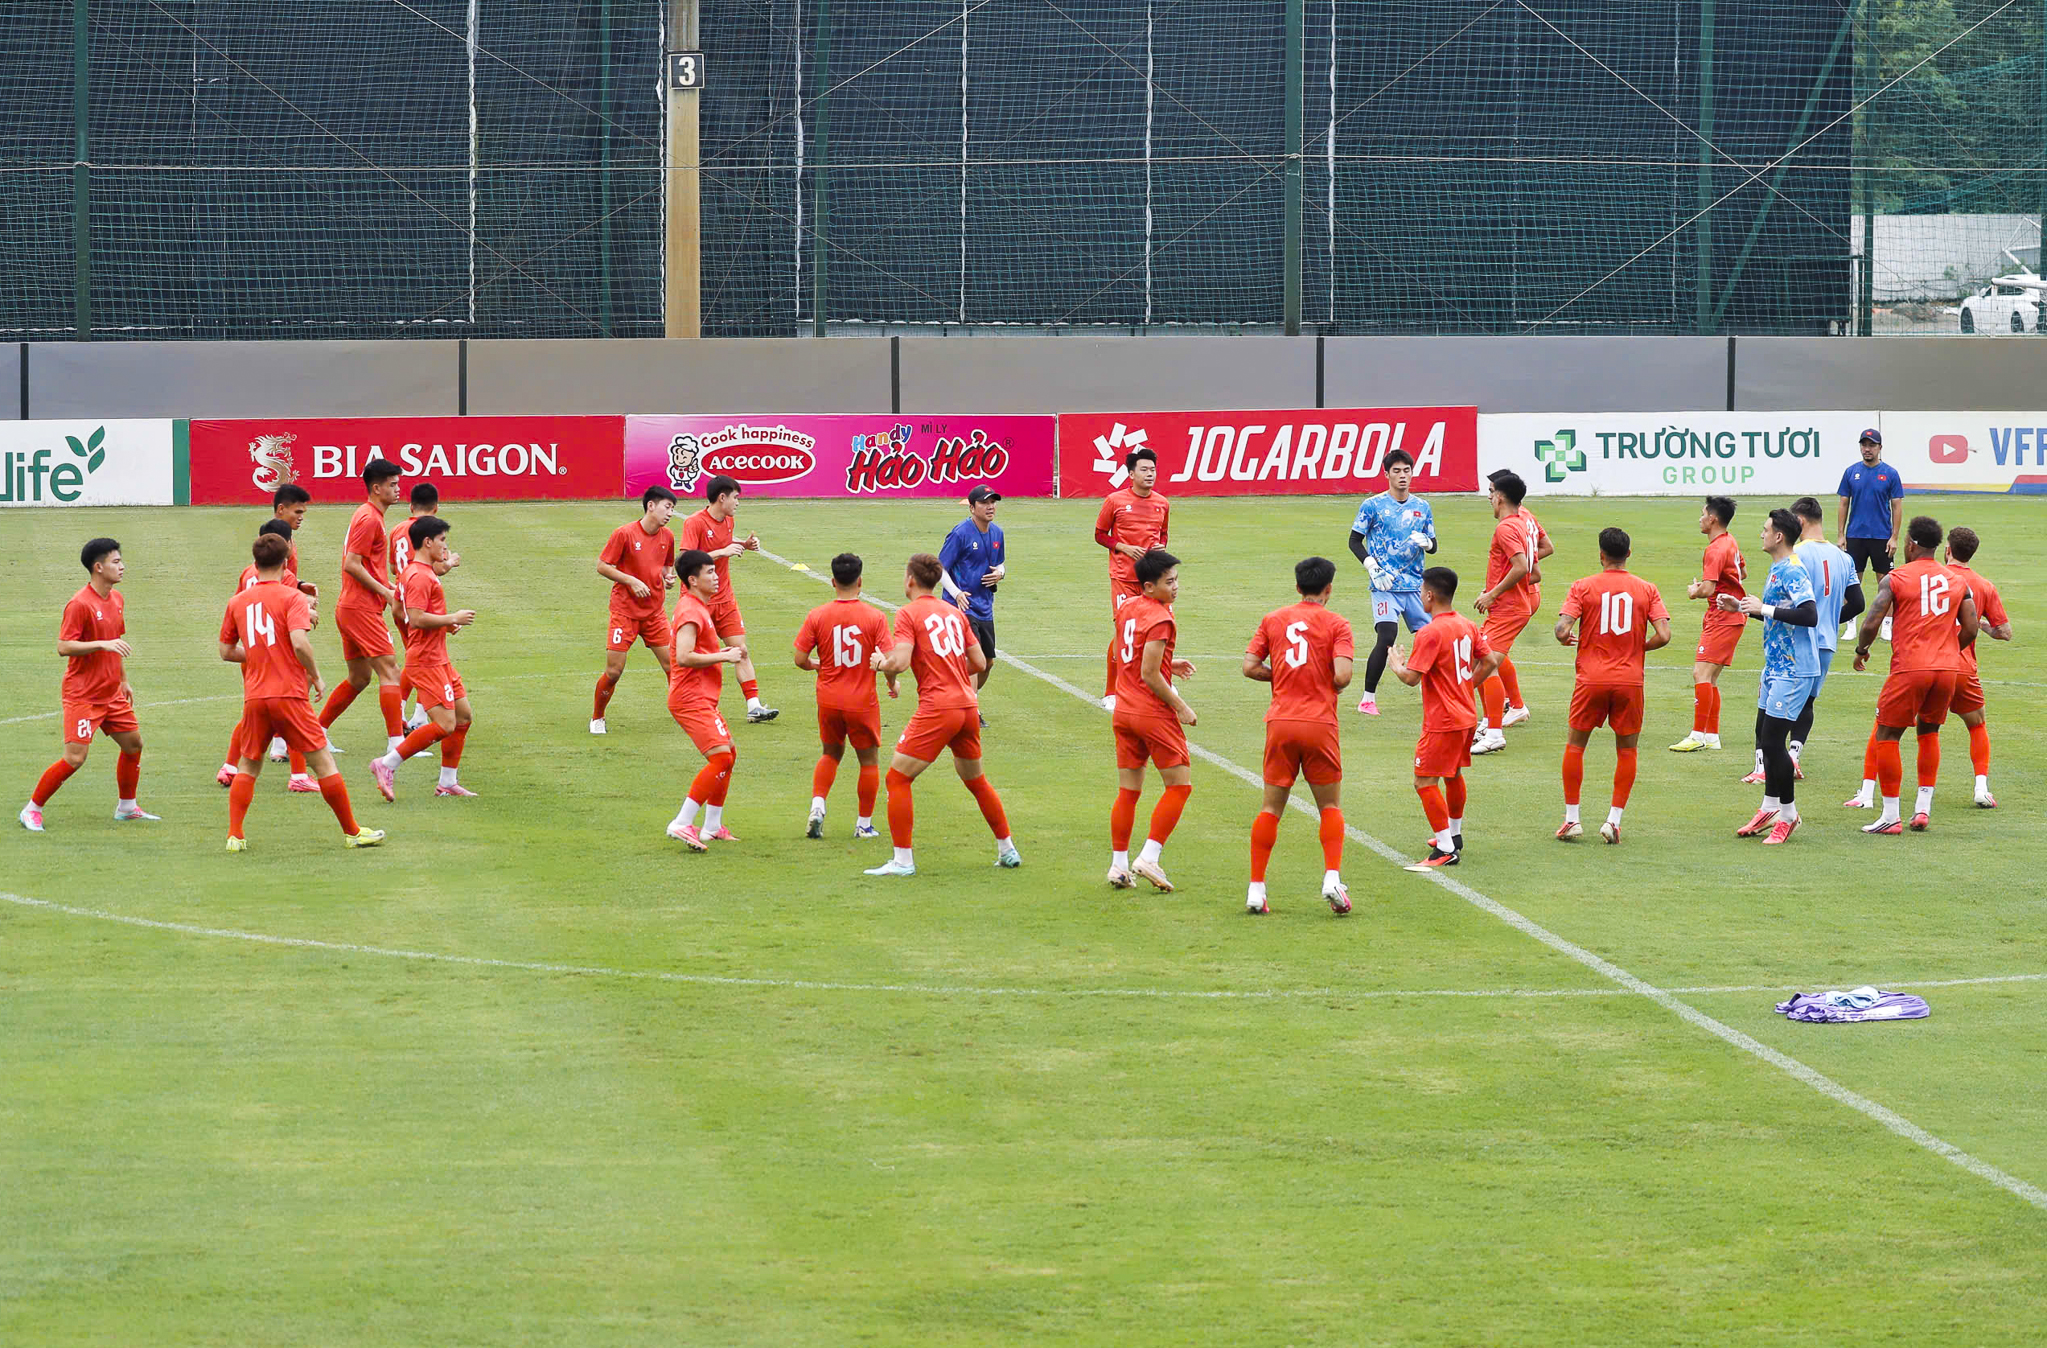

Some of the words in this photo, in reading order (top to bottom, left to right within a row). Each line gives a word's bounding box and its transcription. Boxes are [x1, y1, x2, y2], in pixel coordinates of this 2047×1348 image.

[678, 56, 696, 86] 3
[701, 429, 737, 448] Cook
[741, 427, 813, 448] happiness
[851, 424, 912, 452] Handy
[936, 424, 948, 434] LY
[1595, 425, 1736, 459] TRƯỜNG
[1741, 427, 1820, 459] TƯƠI
[400, 443, 559, 477] SAIGON
[847, 441, 927, 493] Hảo
[928, 430, 1009, 483] Hảo
[1663, 466, 1755, 484] GROUP
[1823, 560, 1830, 597] 1
[1920, 574, 1950, 617] 12
[246, 602, 276, 649] 14
[1600, 591, 1634, 636] 10
[612, 628, 623, 644] 6
[833, 624, 862, 668] 15
[924, 613, 965, 658] 20
[1121, 618, 1136, 664] 9
[1285, 621, 1309, 669] 5
[1453, 634, 1473, 685] 19
[77, 718, 92, 738] 24
